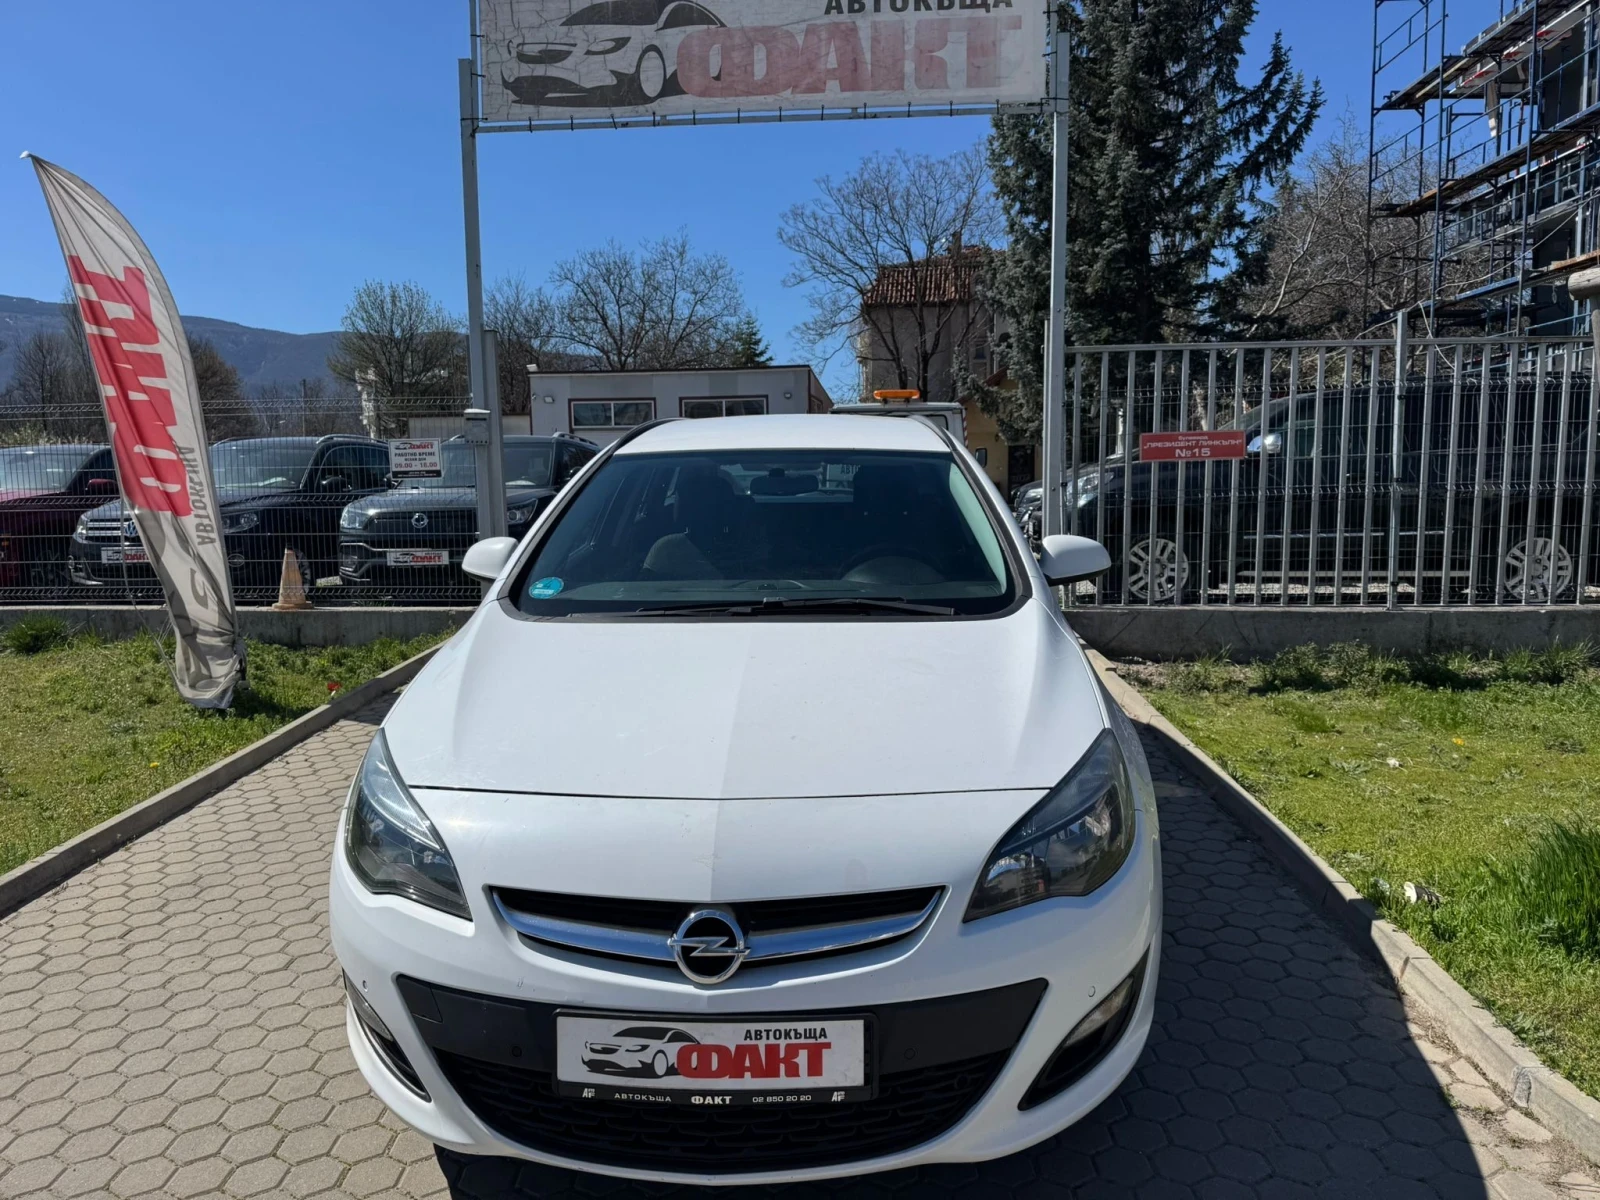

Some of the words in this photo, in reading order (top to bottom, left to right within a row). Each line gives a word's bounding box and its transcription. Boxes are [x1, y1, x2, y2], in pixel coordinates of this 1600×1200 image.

[676, 15, 1022, 98] ФАКТ
[743, 1027, 828, 1041] АВТОКЪЩА
[677, 1042, 832, 1079] ФАКТ
[691, 1095, 733, 1105] ФАКТ
[766, 1095, 784, 1103] 850
